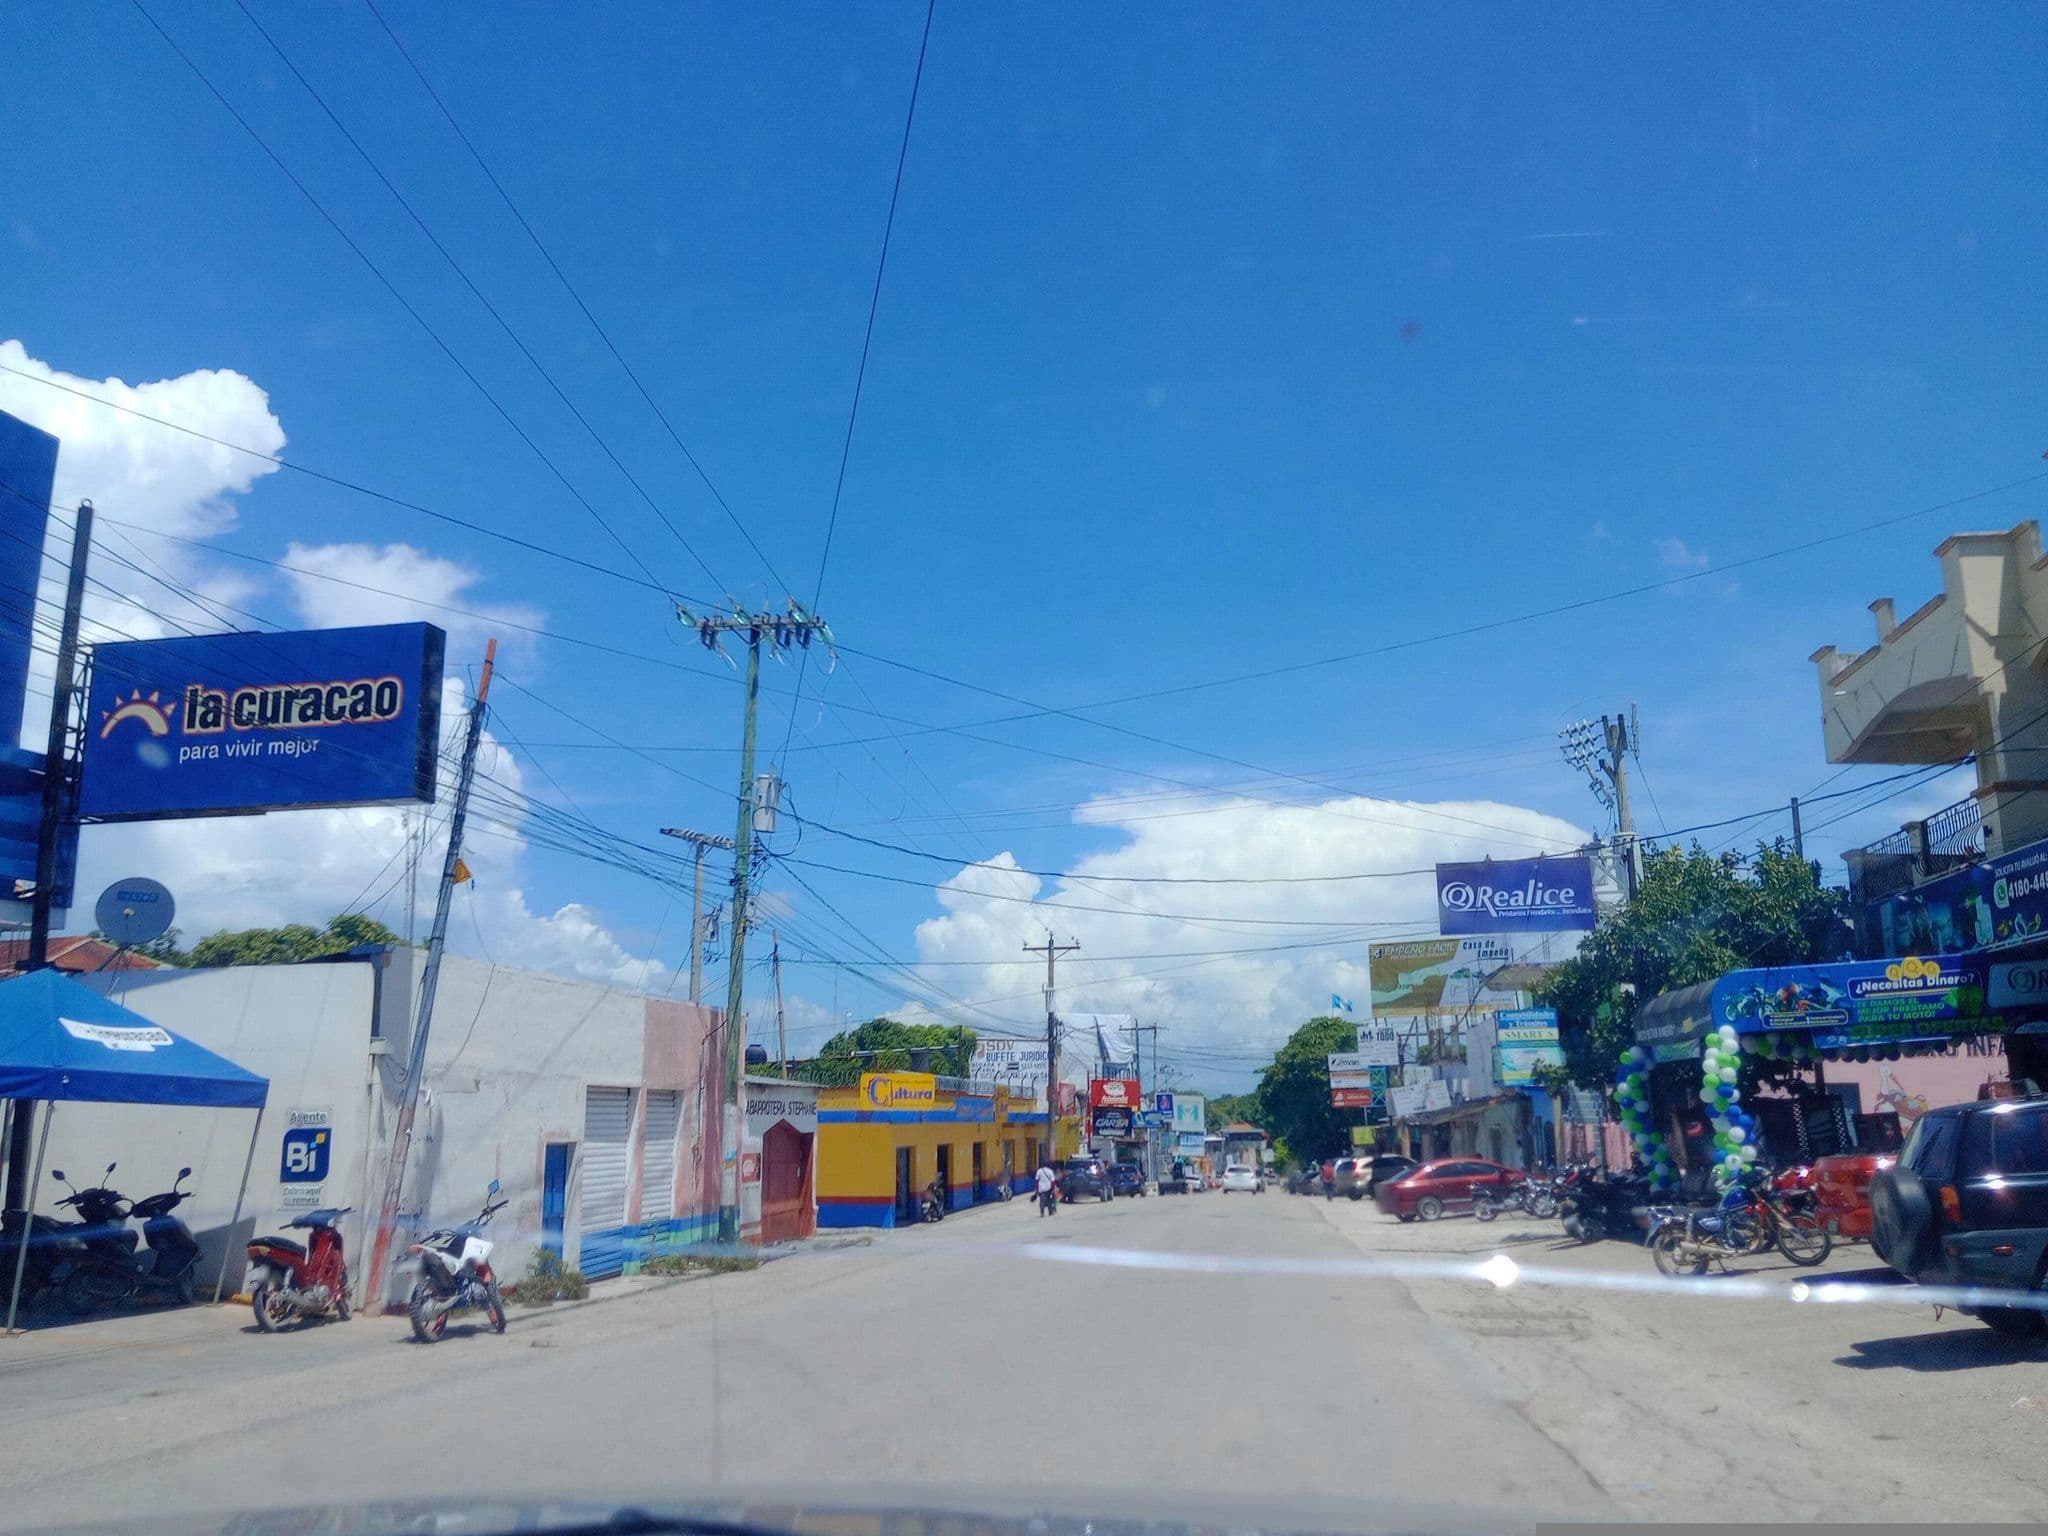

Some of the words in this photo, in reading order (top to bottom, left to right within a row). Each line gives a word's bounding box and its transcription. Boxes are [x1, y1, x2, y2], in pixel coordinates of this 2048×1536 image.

[184, 686, 224, 731] la
[233, 677, 401, 727] curacao
[179, 741, 219, 764] para
[225, 738, 262, 758] vivir
[268, 735, 320, 759] mejor
[1462, 940, 1483, 949] Casa
[1485, 939, 1496, 949] de
[986, 1051, 1016, 1062] BUFETE
[867, 1075, 933, 1107] Cultura
[290, 1111, 328, 1126] Agente
